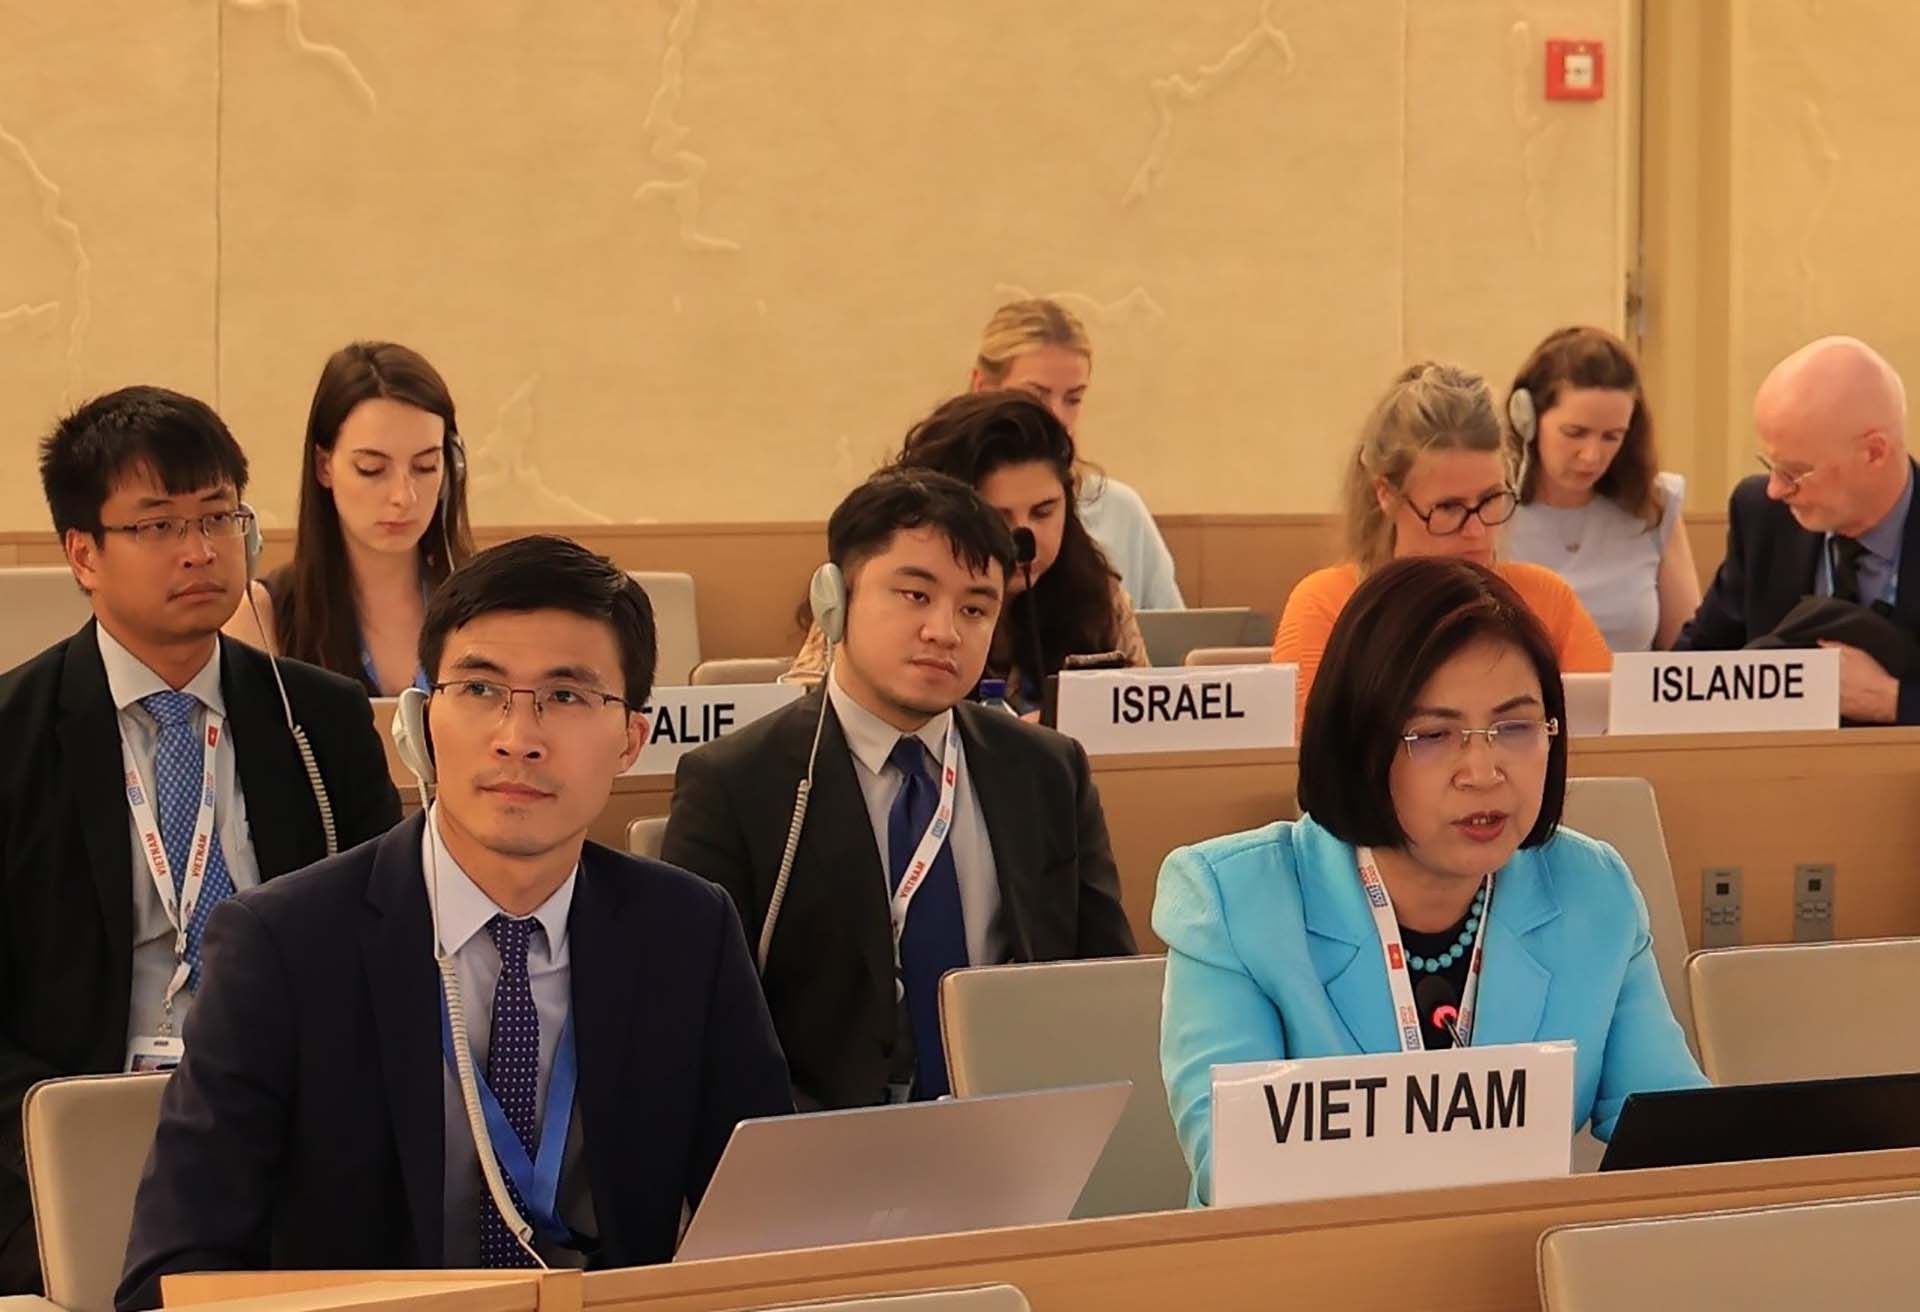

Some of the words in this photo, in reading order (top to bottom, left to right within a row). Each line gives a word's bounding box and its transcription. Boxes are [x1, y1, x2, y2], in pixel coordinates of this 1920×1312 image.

[1112, 682, 1245, 724] ISRAEL
[1652, 663, 1804, 703] ISLANDE
[641, 703, 735, 744] ALIE
[145, 832, 167, 877] VIETNAM
[192, 834, 208, 877] VIETNAM
[899, 861, 926, 898] VIETNAM
[1263, 1076, 1388, 1144] VIET
[1404, 1068, 1527, 1135] NAM
